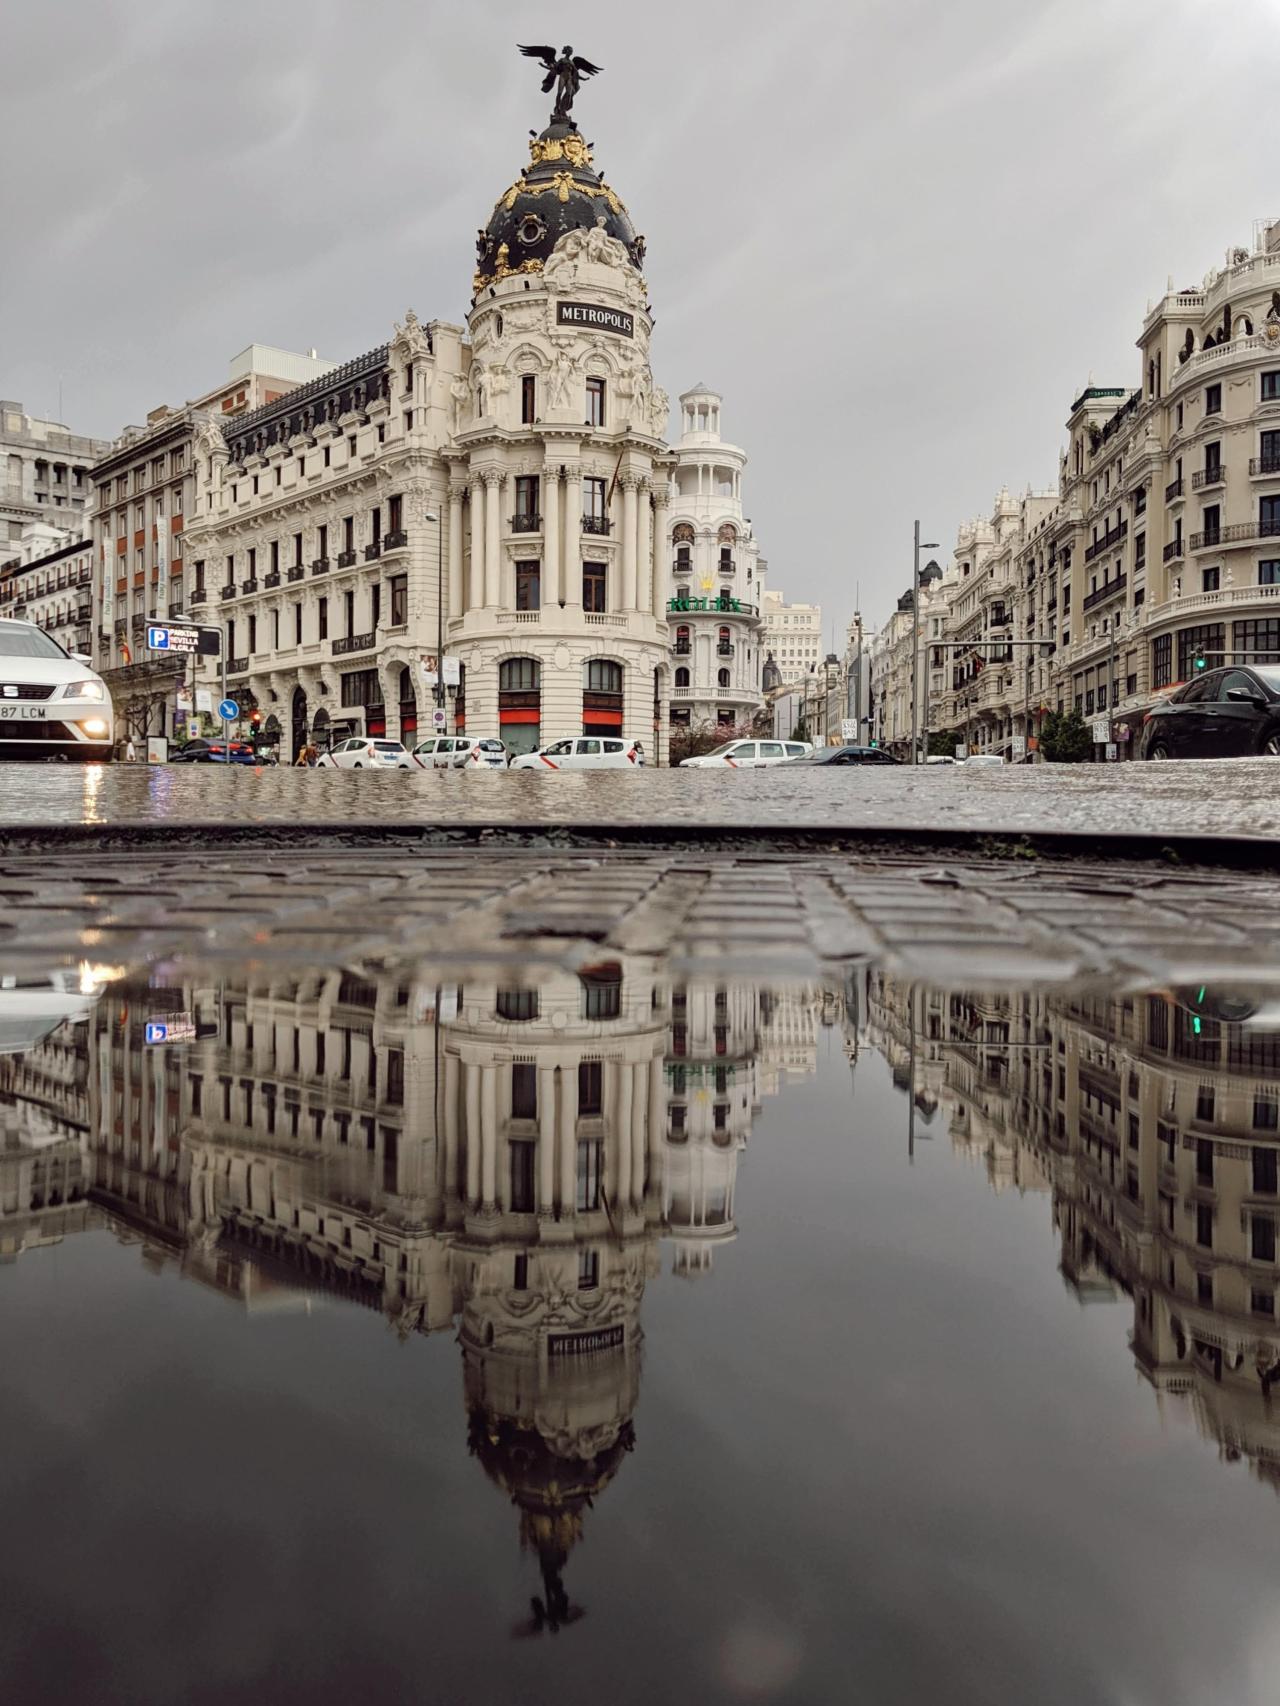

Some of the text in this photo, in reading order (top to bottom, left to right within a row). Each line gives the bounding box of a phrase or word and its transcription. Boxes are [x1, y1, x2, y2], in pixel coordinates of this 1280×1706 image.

[562, 307, 632, 331] METROPOLIS
[669, 596, 741, 612] ROLEX
[154, 630, 165, 646] P
[169, 636, 199, 645] SEVILLA
[1, 707, 46, 718] 87 LCM
